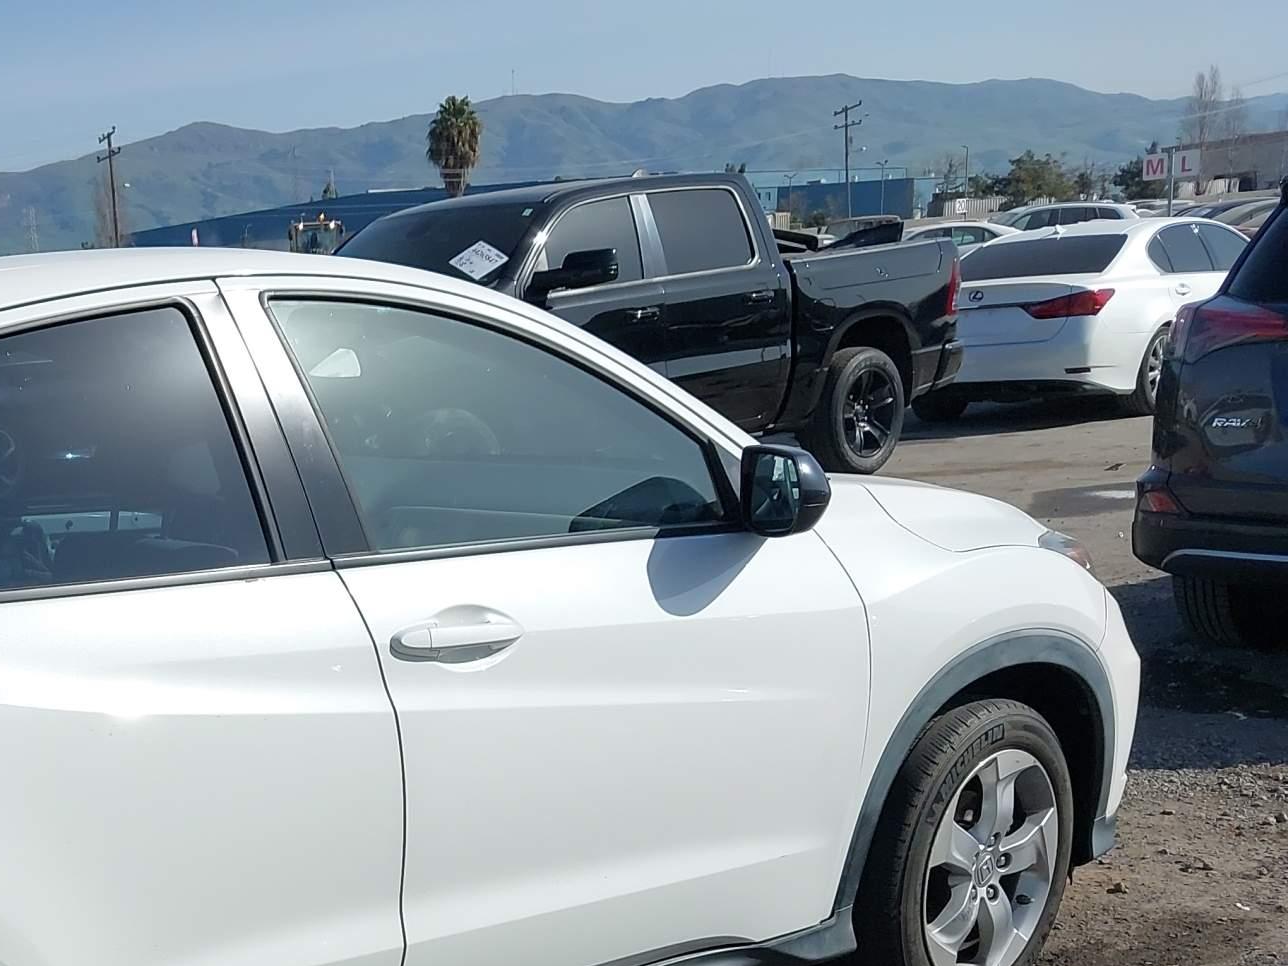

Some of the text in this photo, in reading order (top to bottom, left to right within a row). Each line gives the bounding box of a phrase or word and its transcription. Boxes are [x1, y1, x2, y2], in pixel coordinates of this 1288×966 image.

[1146, 158, 1164, 176] M
[1181, 155, 1192, 172] L
[925, 723, 1005, 825] MICHELIN
